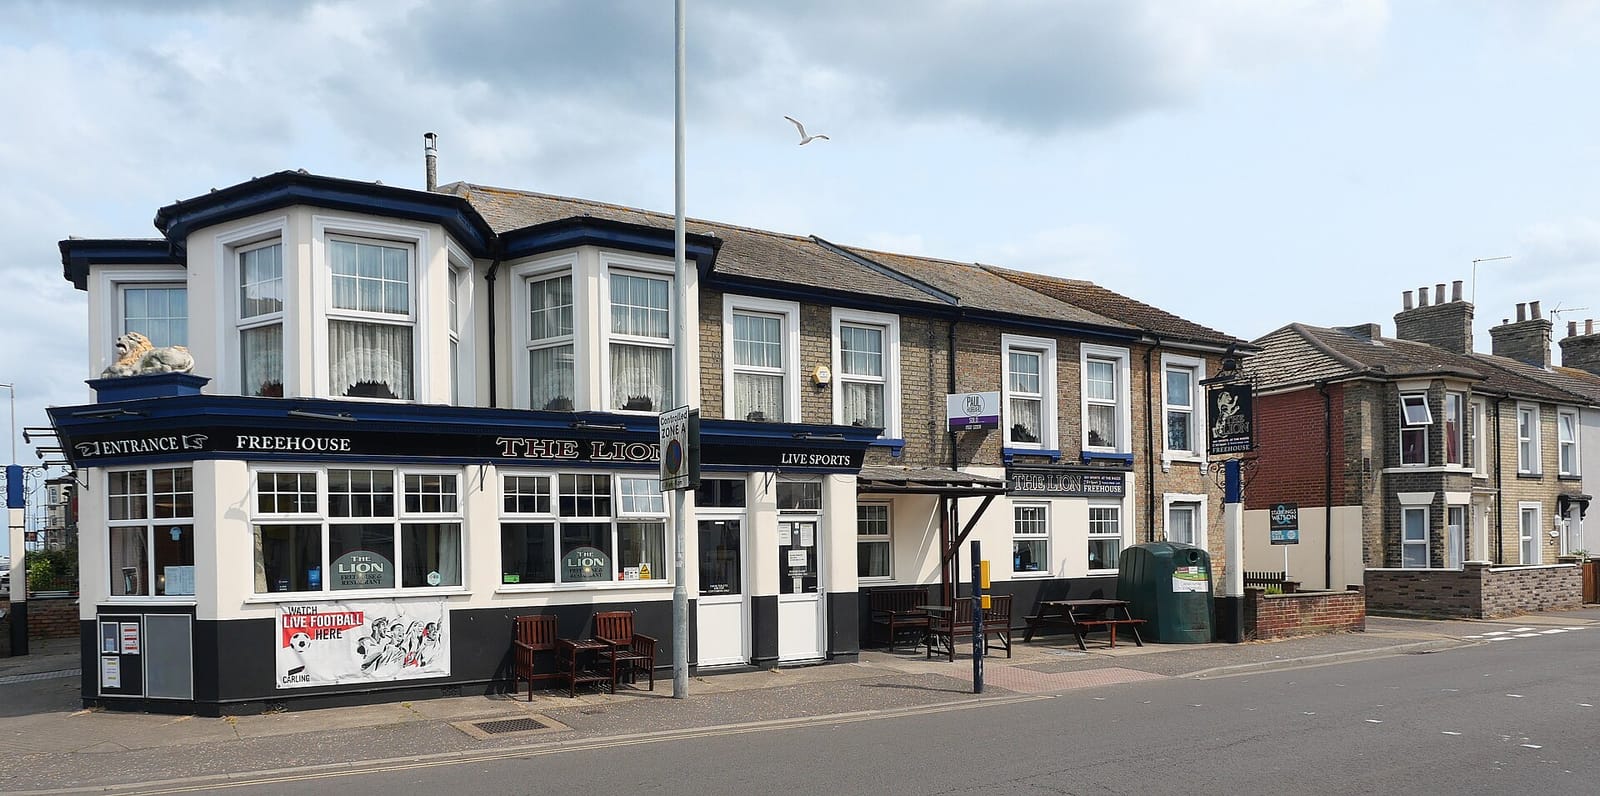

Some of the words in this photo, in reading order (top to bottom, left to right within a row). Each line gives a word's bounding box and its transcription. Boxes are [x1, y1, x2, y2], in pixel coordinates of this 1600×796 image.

[661, 409, 687, 426] Controlled
[661, 424, 679, 439] ZONE
[681, 422, 686, 434] A
[1223, 421, 1250, 435] LION
[103, 436, 178, 455] ENTRANCE
[236, 435, 351, 451] FREEHOUSE
[496, 436, 579, 459] THE
[1212, 444, 1250, 454] FREEHOUSE
[781, 453, 807, 465] LIVE
[809, 454, 851, 466] SPORTS
[1012, 473, 1046, 492] THE
[1047, 474, 1082, 492] LION
[1083, 485, 1121, 493] FREEHOUSE
[338, 562, 384, 573] LION
[567, 557, 604, 567] LION
[288, 606, 318, 615] WATCH
[283, 615, 307, 628] LIVE
[310, 614, 363, 627] FOOTBALL
[315, 628, 343, 640] HERE
[282, 675, 311, 684] CARLING
